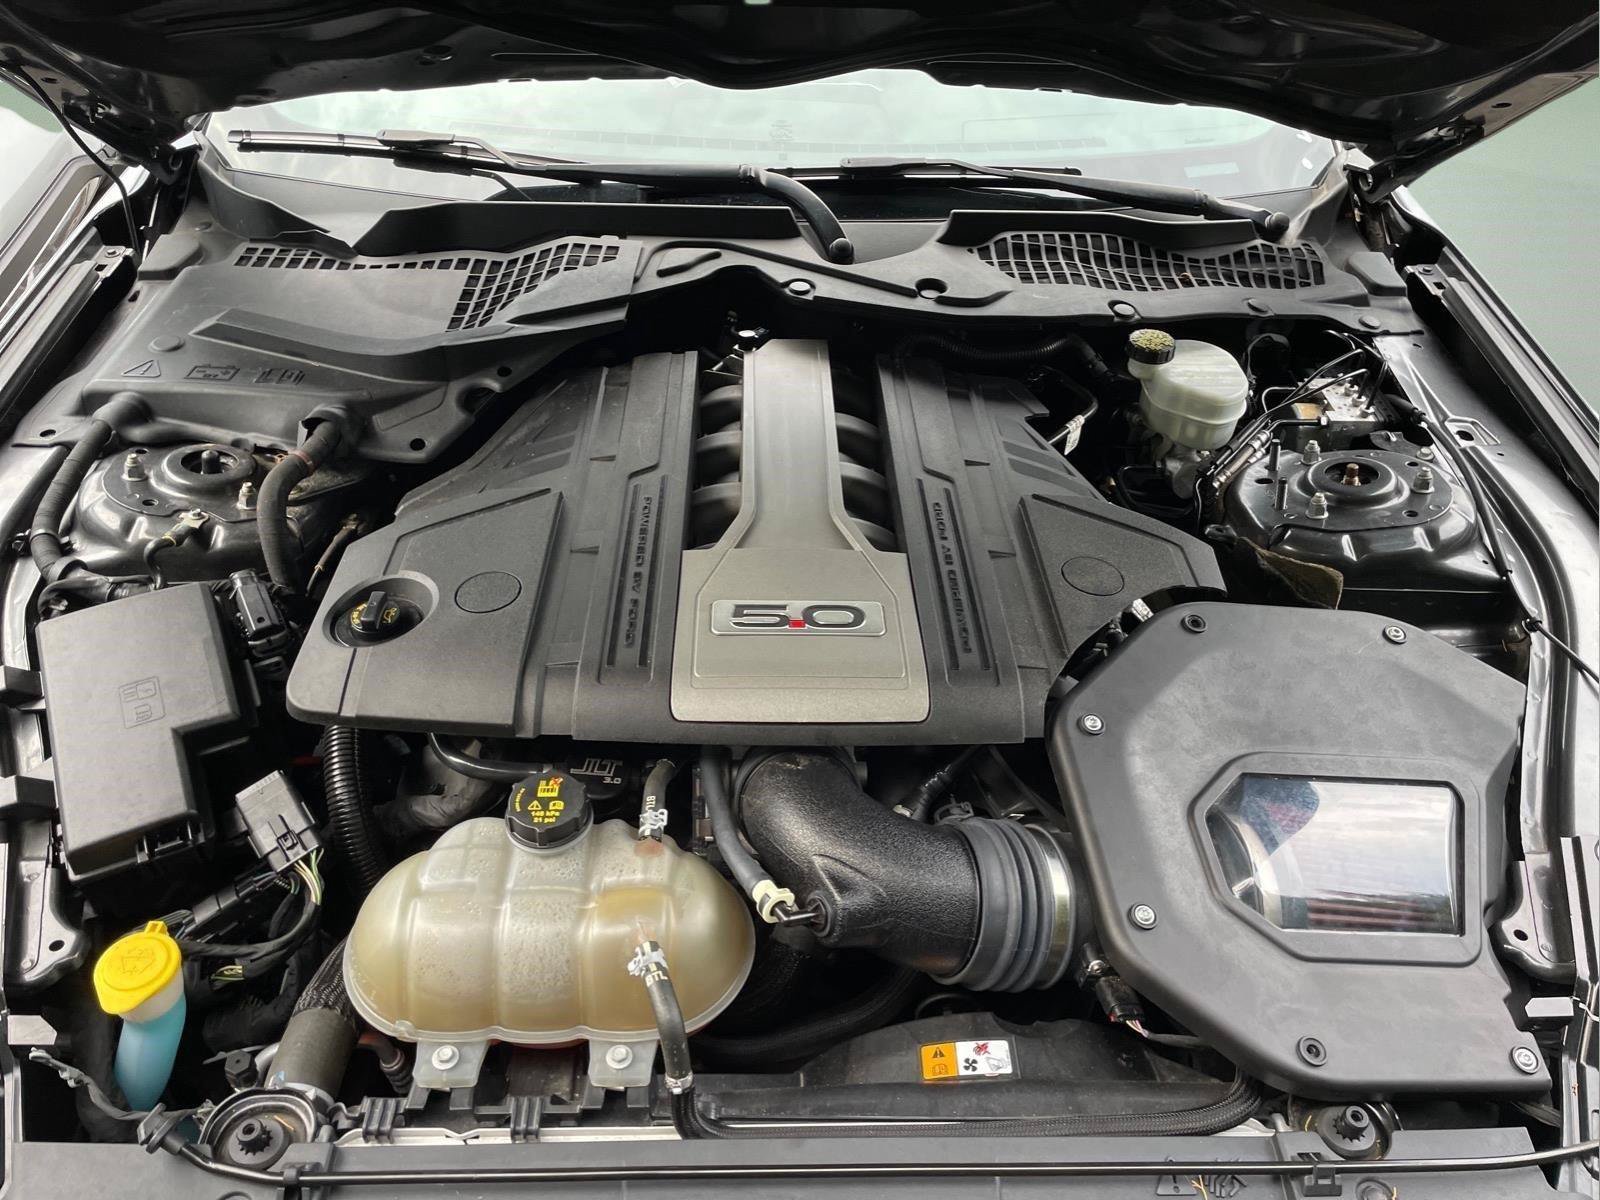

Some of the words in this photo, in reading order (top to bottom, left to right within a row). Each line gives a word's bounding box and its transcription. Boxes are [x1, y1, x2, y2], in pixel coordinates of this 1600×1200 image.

[636, 496, 652, 568] POWERED
[932, 501, 949, 541] FORD
[941, 543, 954, 566] BY
[632, 571, 643, 594] BY
[624, 598, 639, 649] FORD
[729, 603, 866, 630] 5.0
[947, 569, 973, 654] POWERED
[569, 757, 624, 777] JLT
[602, 776, 622, 784] 3.0
[644, 970, 669, 988] BTL
